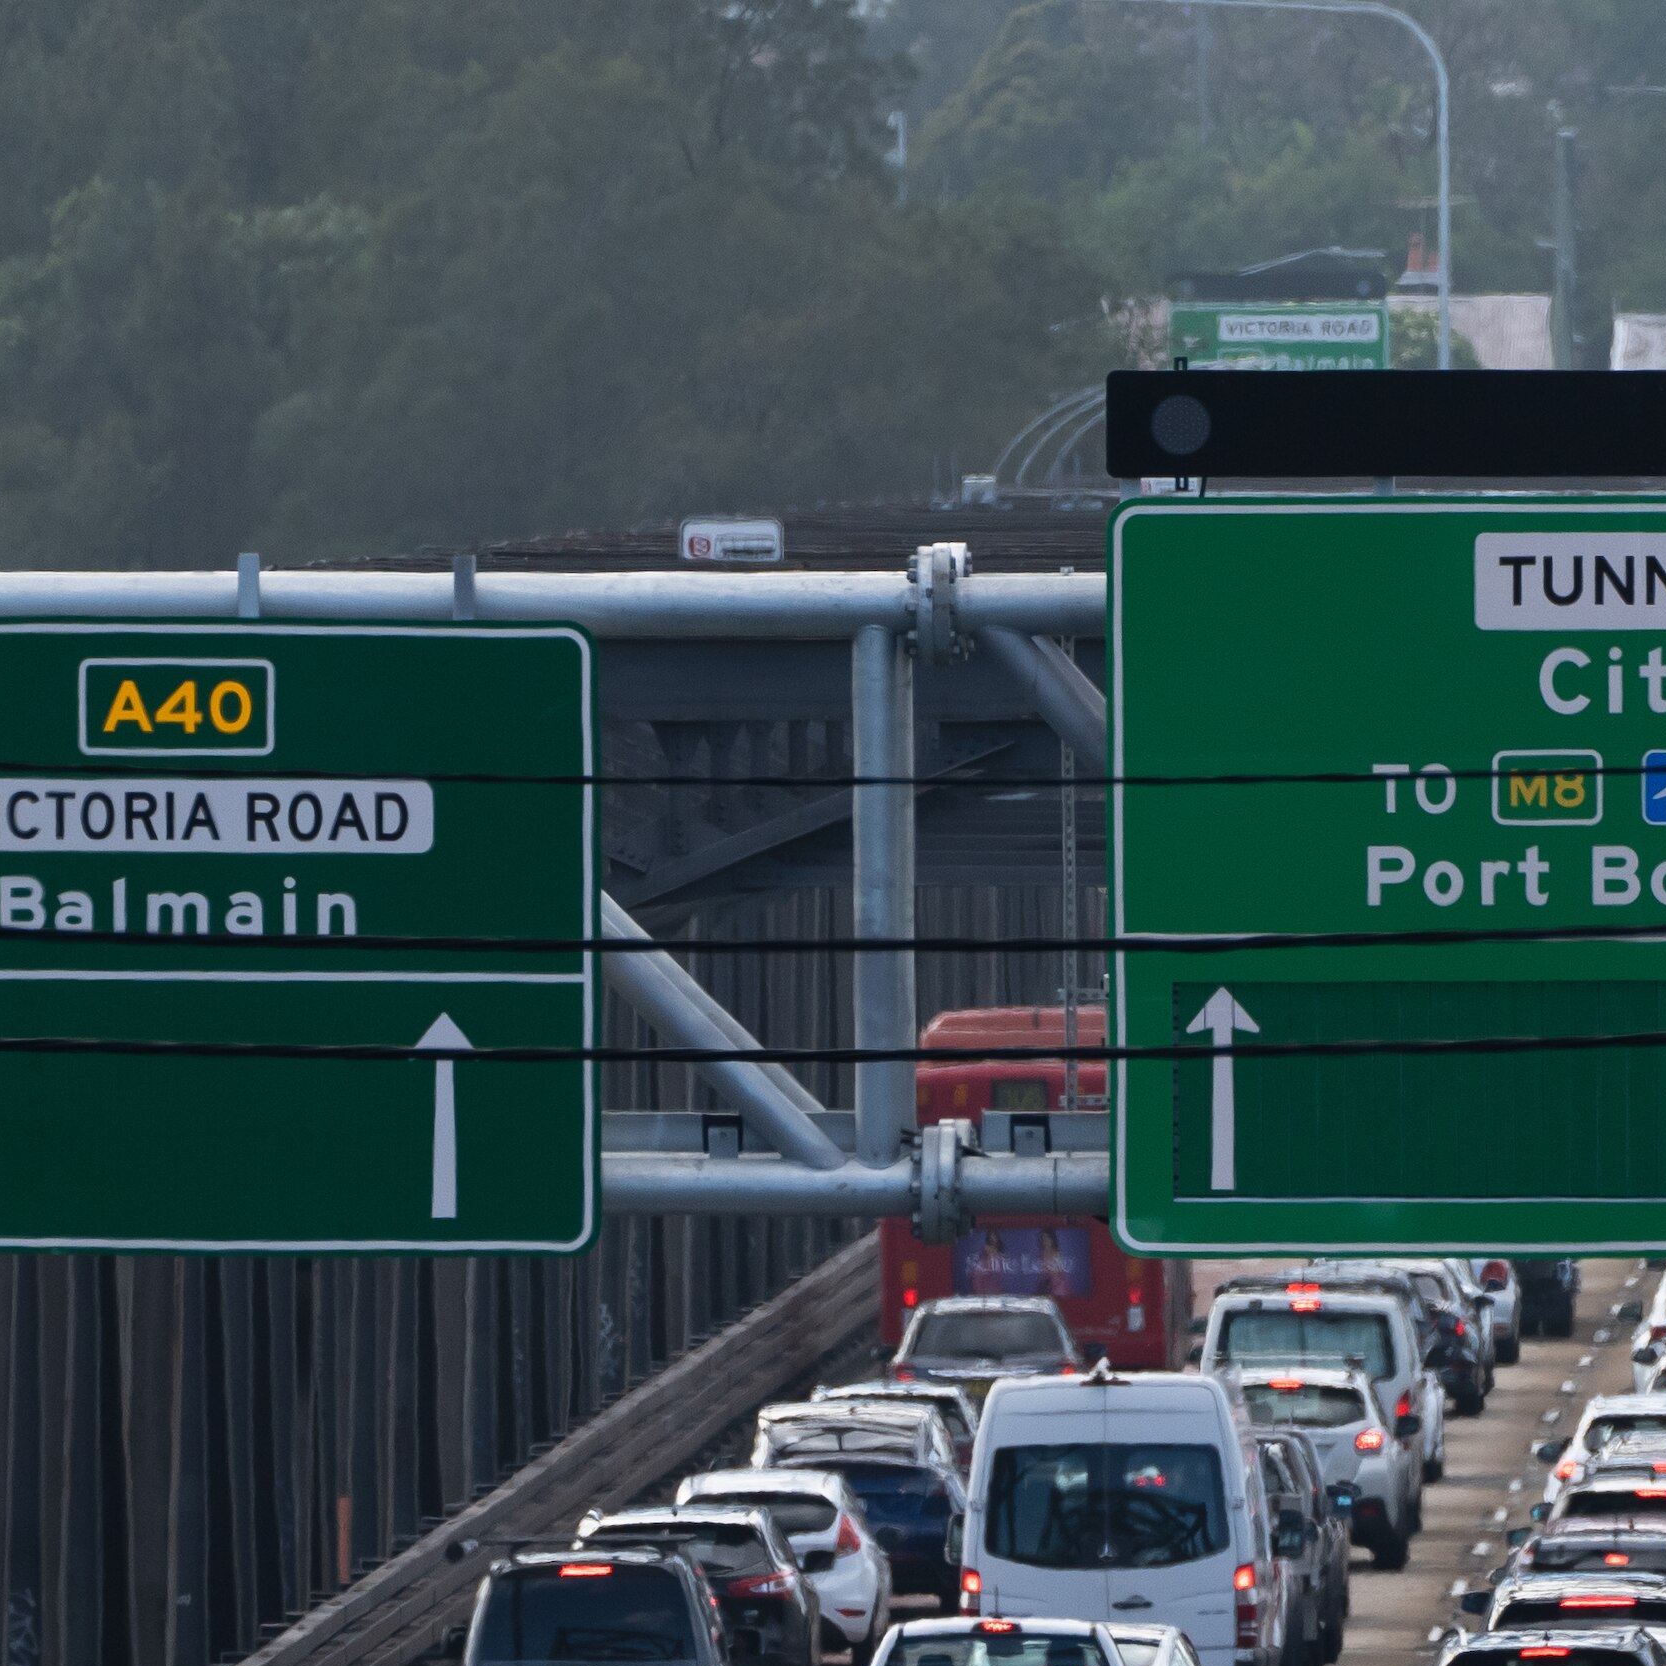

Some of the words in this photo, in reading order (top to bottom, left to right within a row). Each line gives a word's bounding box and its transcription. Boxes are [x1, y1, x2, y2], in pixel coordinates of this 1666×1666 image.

[1225, 320, 1312, 335] VICTORIA
[1320, 320, 1373, 335] ROAD
[102, 679, 254, 736] A40
[1371, 761, 1457, 815] TO
[1509, 768, 1586, 809] M8
[245, 792, 411, 843] ROAD
[1366, 844, 1552, 909] Port
